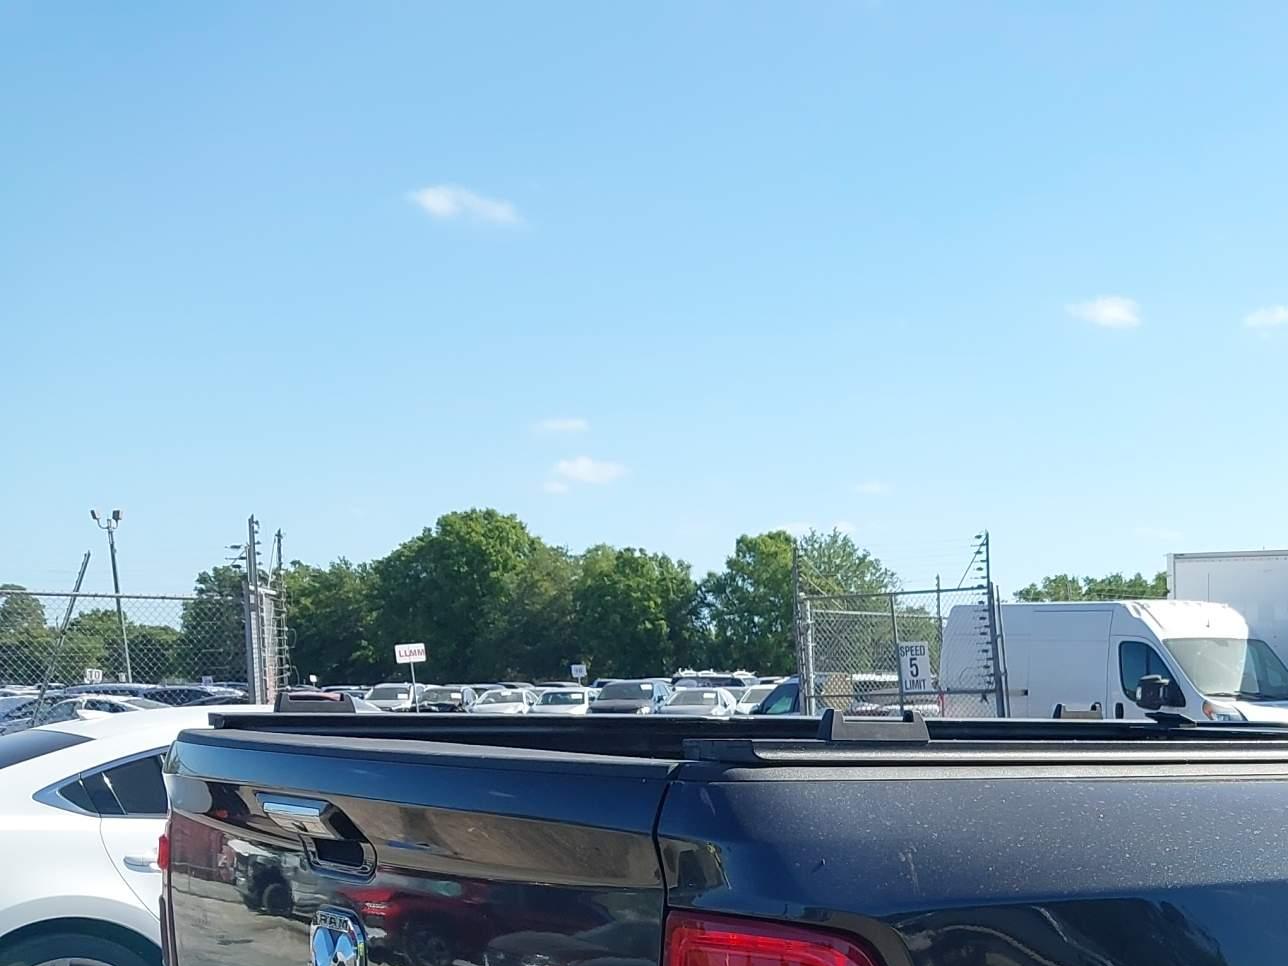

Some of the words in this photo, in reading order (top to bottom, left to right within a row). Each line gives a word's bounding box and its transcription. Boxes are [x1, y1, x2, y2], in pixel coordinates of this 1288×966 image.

[900, 645, 926, 657] SPEED
[909, 657, 919, 678] 5
[904, 679, 927, 691] LIMIT
[319, 913, 349, 932] RAM
